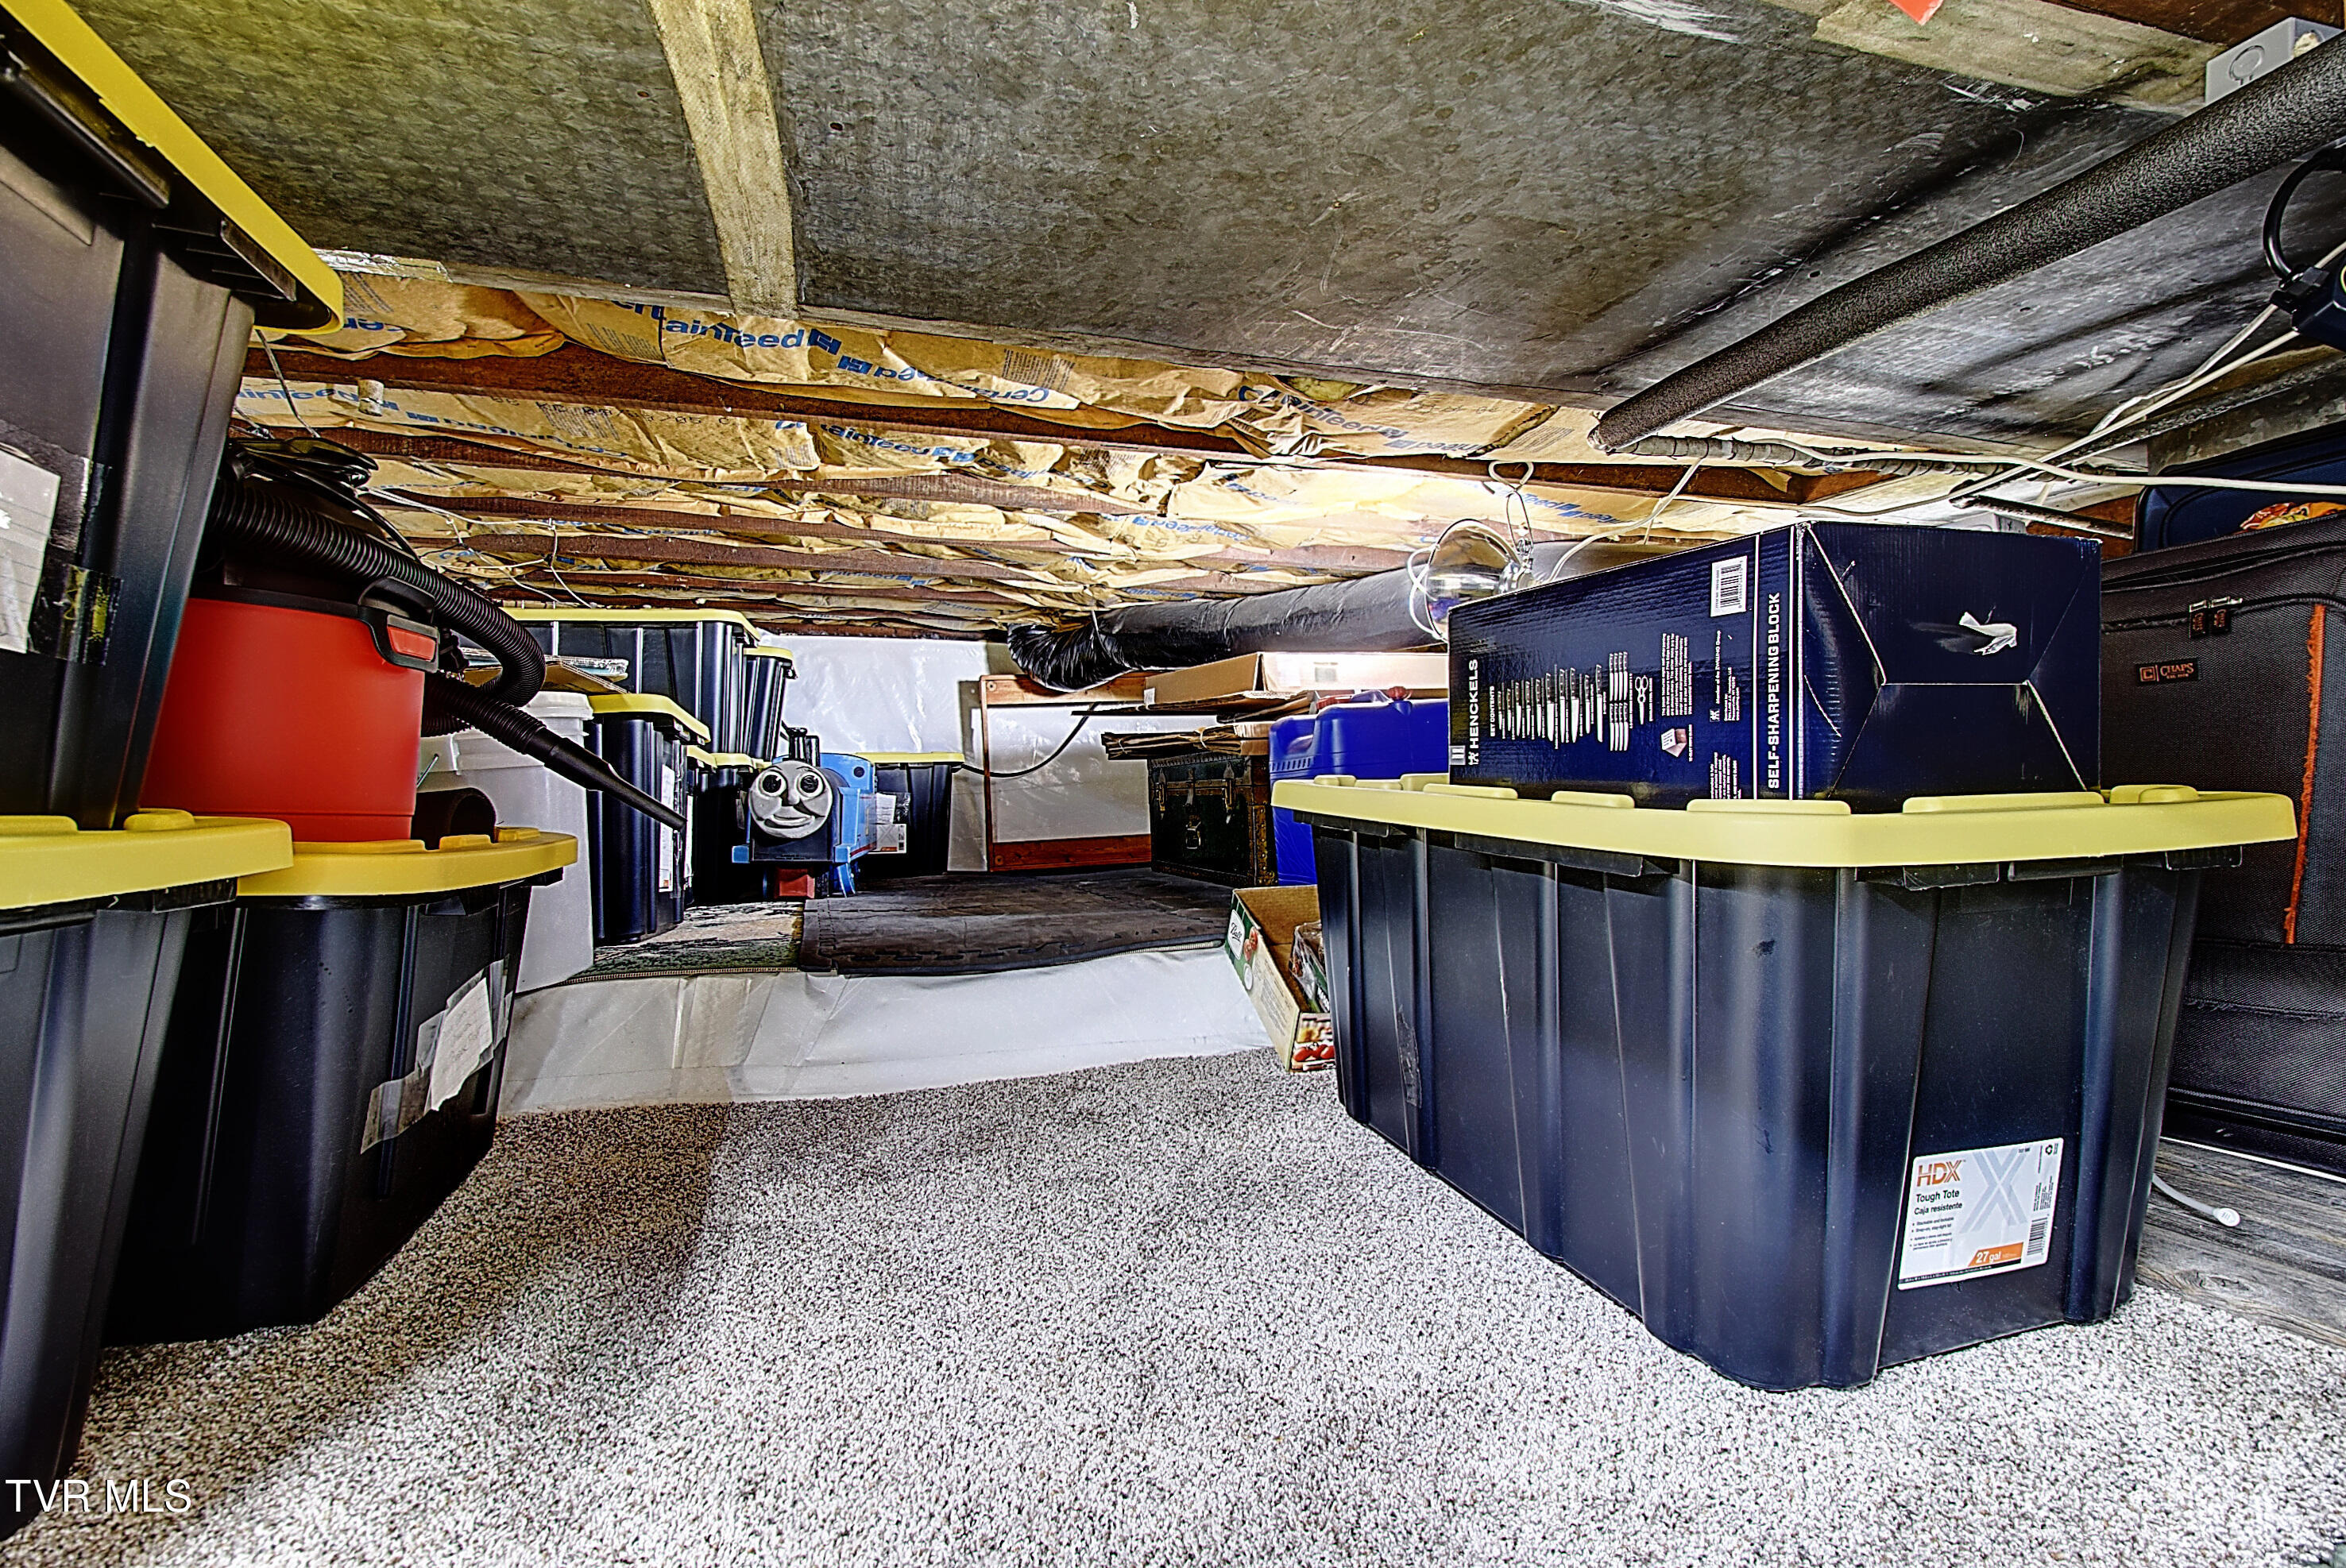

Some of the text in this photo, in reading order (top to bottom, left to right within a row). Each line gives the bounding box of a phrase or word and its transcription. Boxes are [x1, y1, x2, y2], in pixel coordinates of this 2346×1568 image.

[2160, 662, 2194, 676] CHAPS
[1768, 593, 1780, 789] SELF-SHARPENING BLOCK
[1469, 658, 1479, 748] HENCKELS
[1230, 921, 1243, 942] Ball
[1917, 1160, 1961, 1187] HDX
[1915, 1189, 1961, 1203] Tough Tote
[1914, 1201, 1963, 1215] Caja resistente
[1976, 1251, 1989, 1264] 27
[1989, 1251, 2002, 1263] gal
